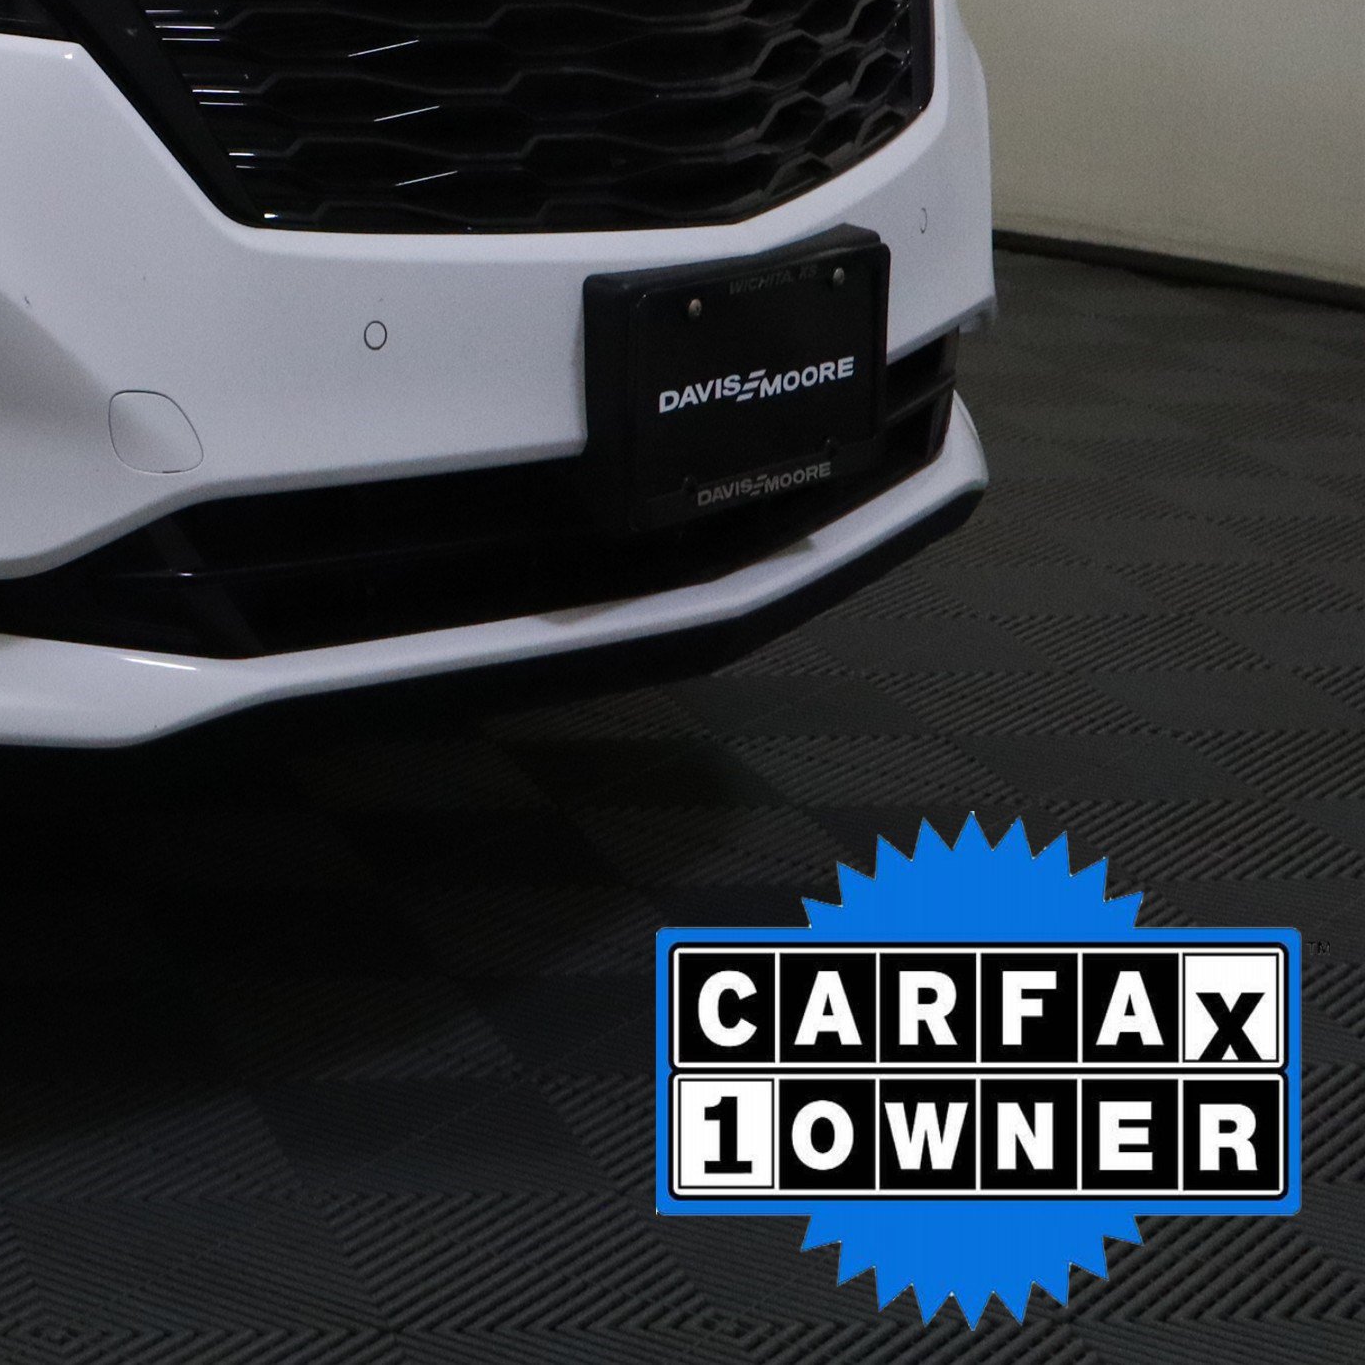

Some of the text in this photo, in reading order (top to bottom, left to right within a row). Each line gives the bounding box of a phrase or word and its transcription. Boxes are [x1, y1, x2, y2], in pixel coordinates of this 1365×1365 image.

[658, 355, 855, 414] DAVIS MOORE
[697, 461, 832, 507] DAVIS MOORE
